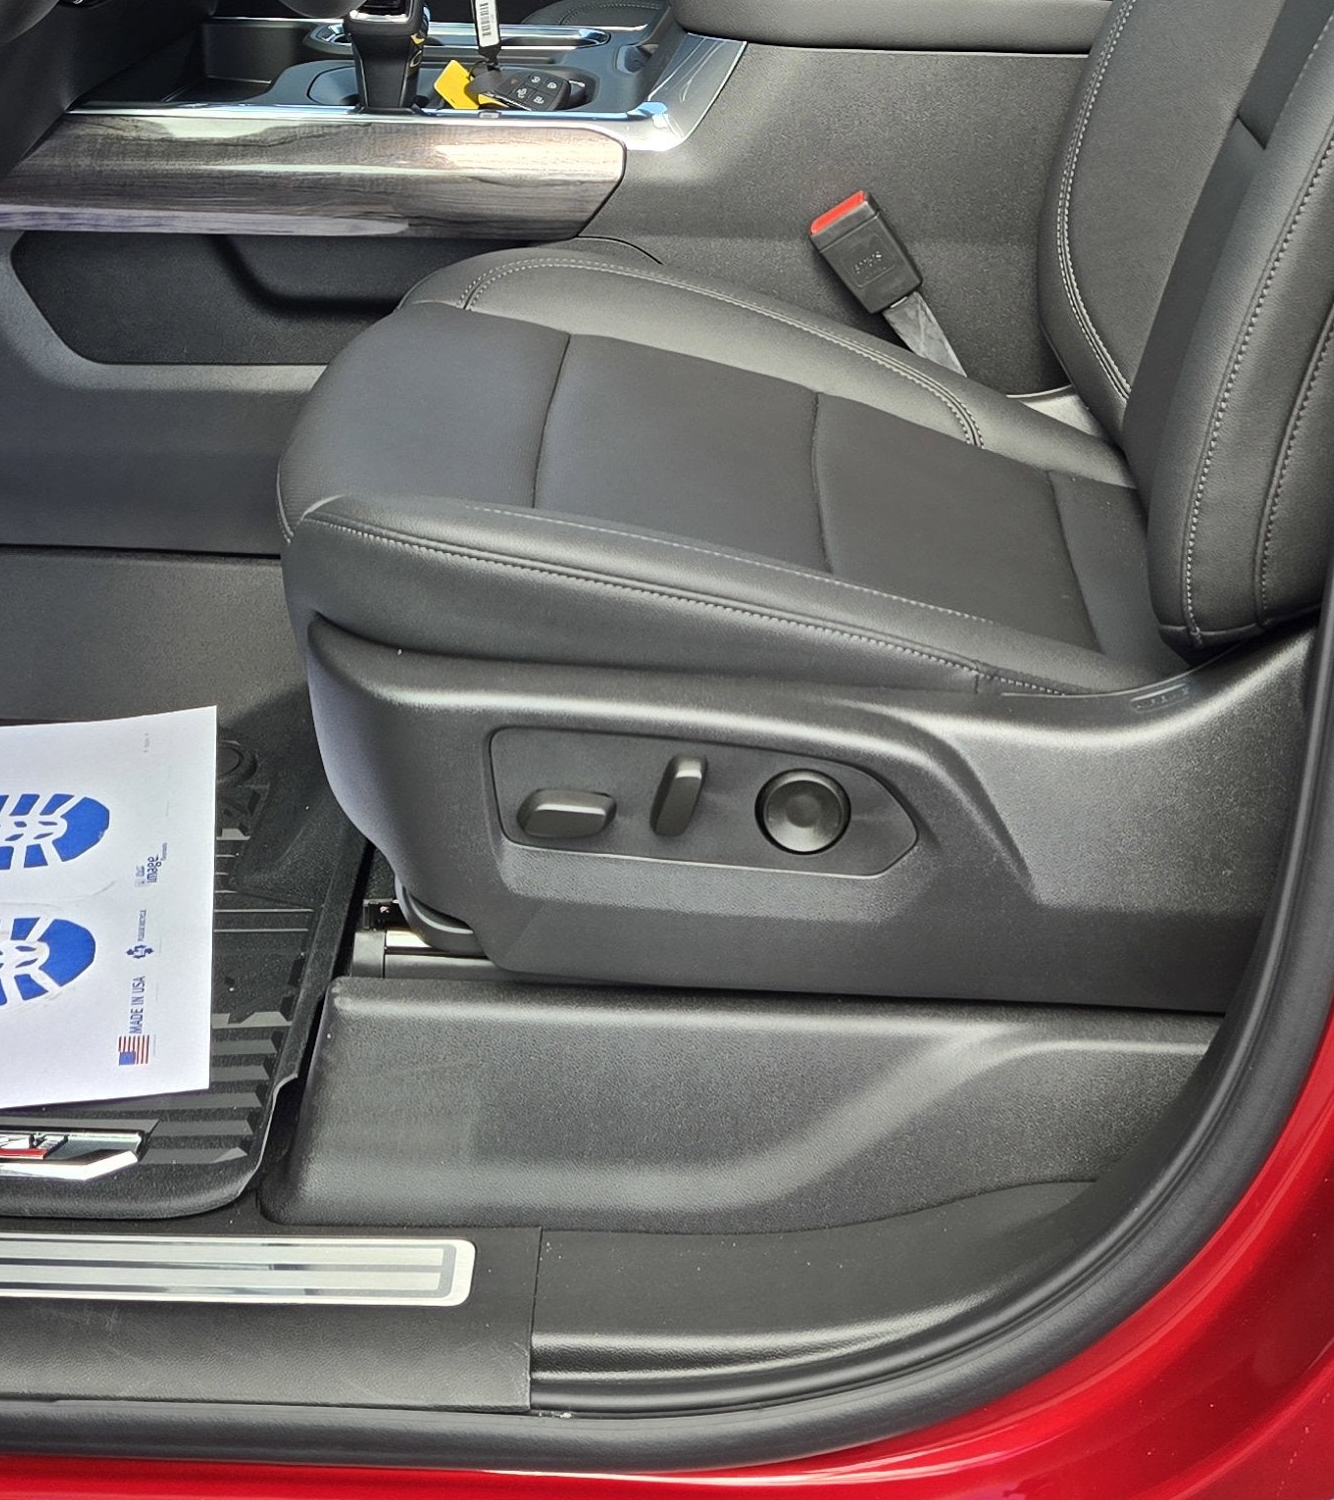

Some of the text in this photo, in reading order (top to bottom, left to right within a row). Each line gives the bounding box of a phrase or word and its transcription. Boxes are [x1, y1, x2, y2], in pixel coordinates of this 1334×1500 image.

[147, 855, 162, 883] image
[129, 975, 146, 1034] MADE IN USA
